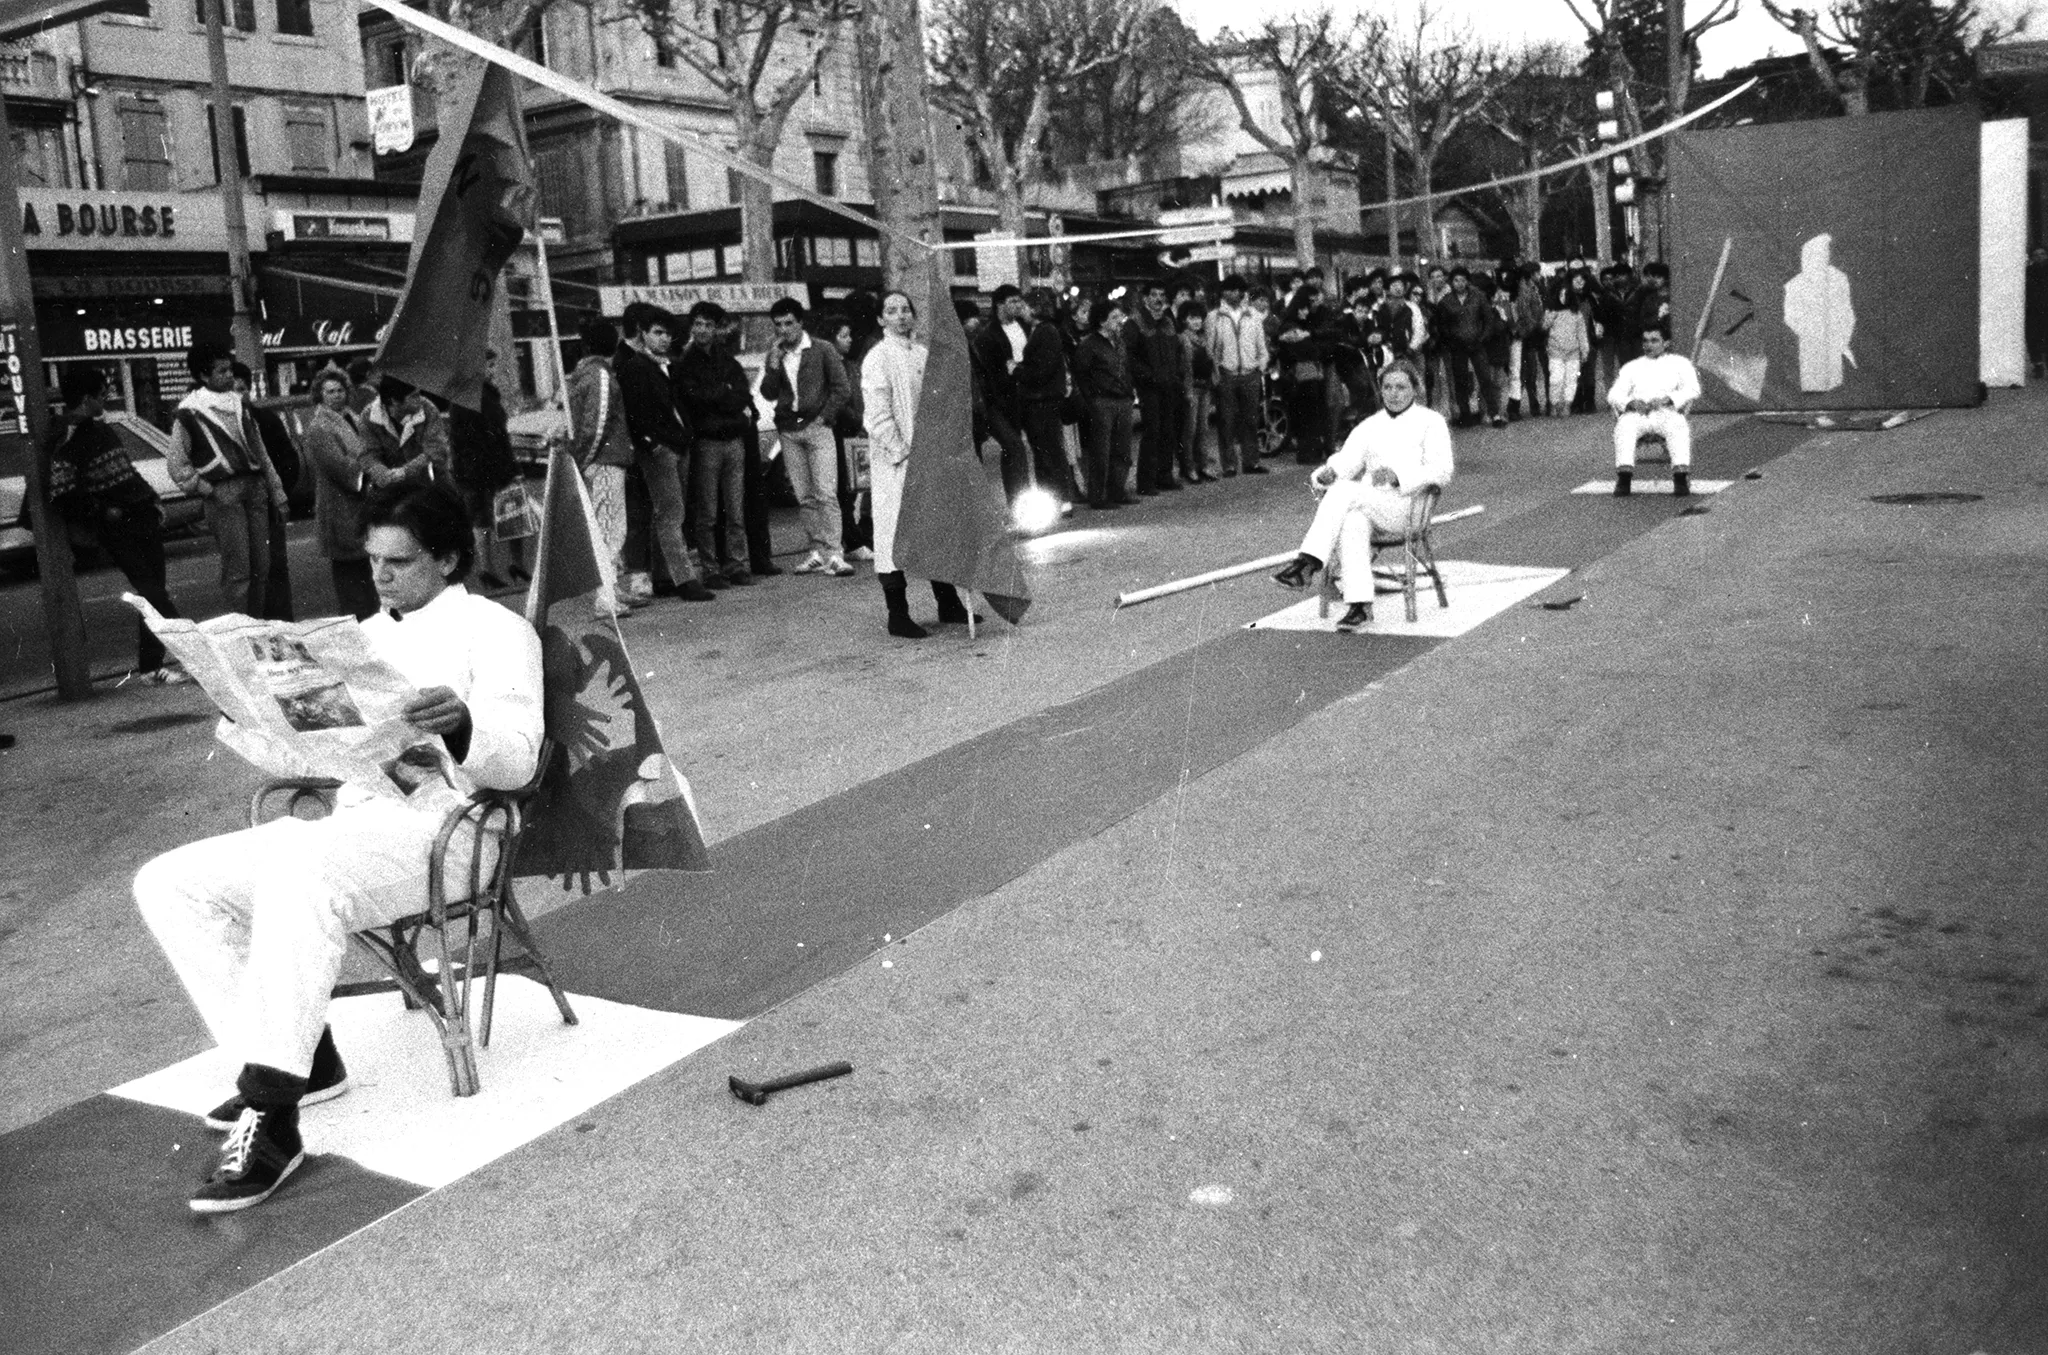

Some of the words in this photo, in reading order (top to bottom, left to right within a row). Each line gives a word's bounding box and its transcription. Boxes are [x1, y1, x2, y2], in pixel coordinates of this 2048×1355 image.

[57, 203, 175, 238] BOURSE
[84, 326, 193, 351] BRASSERIE
[261, 328, 285, 346] nd
